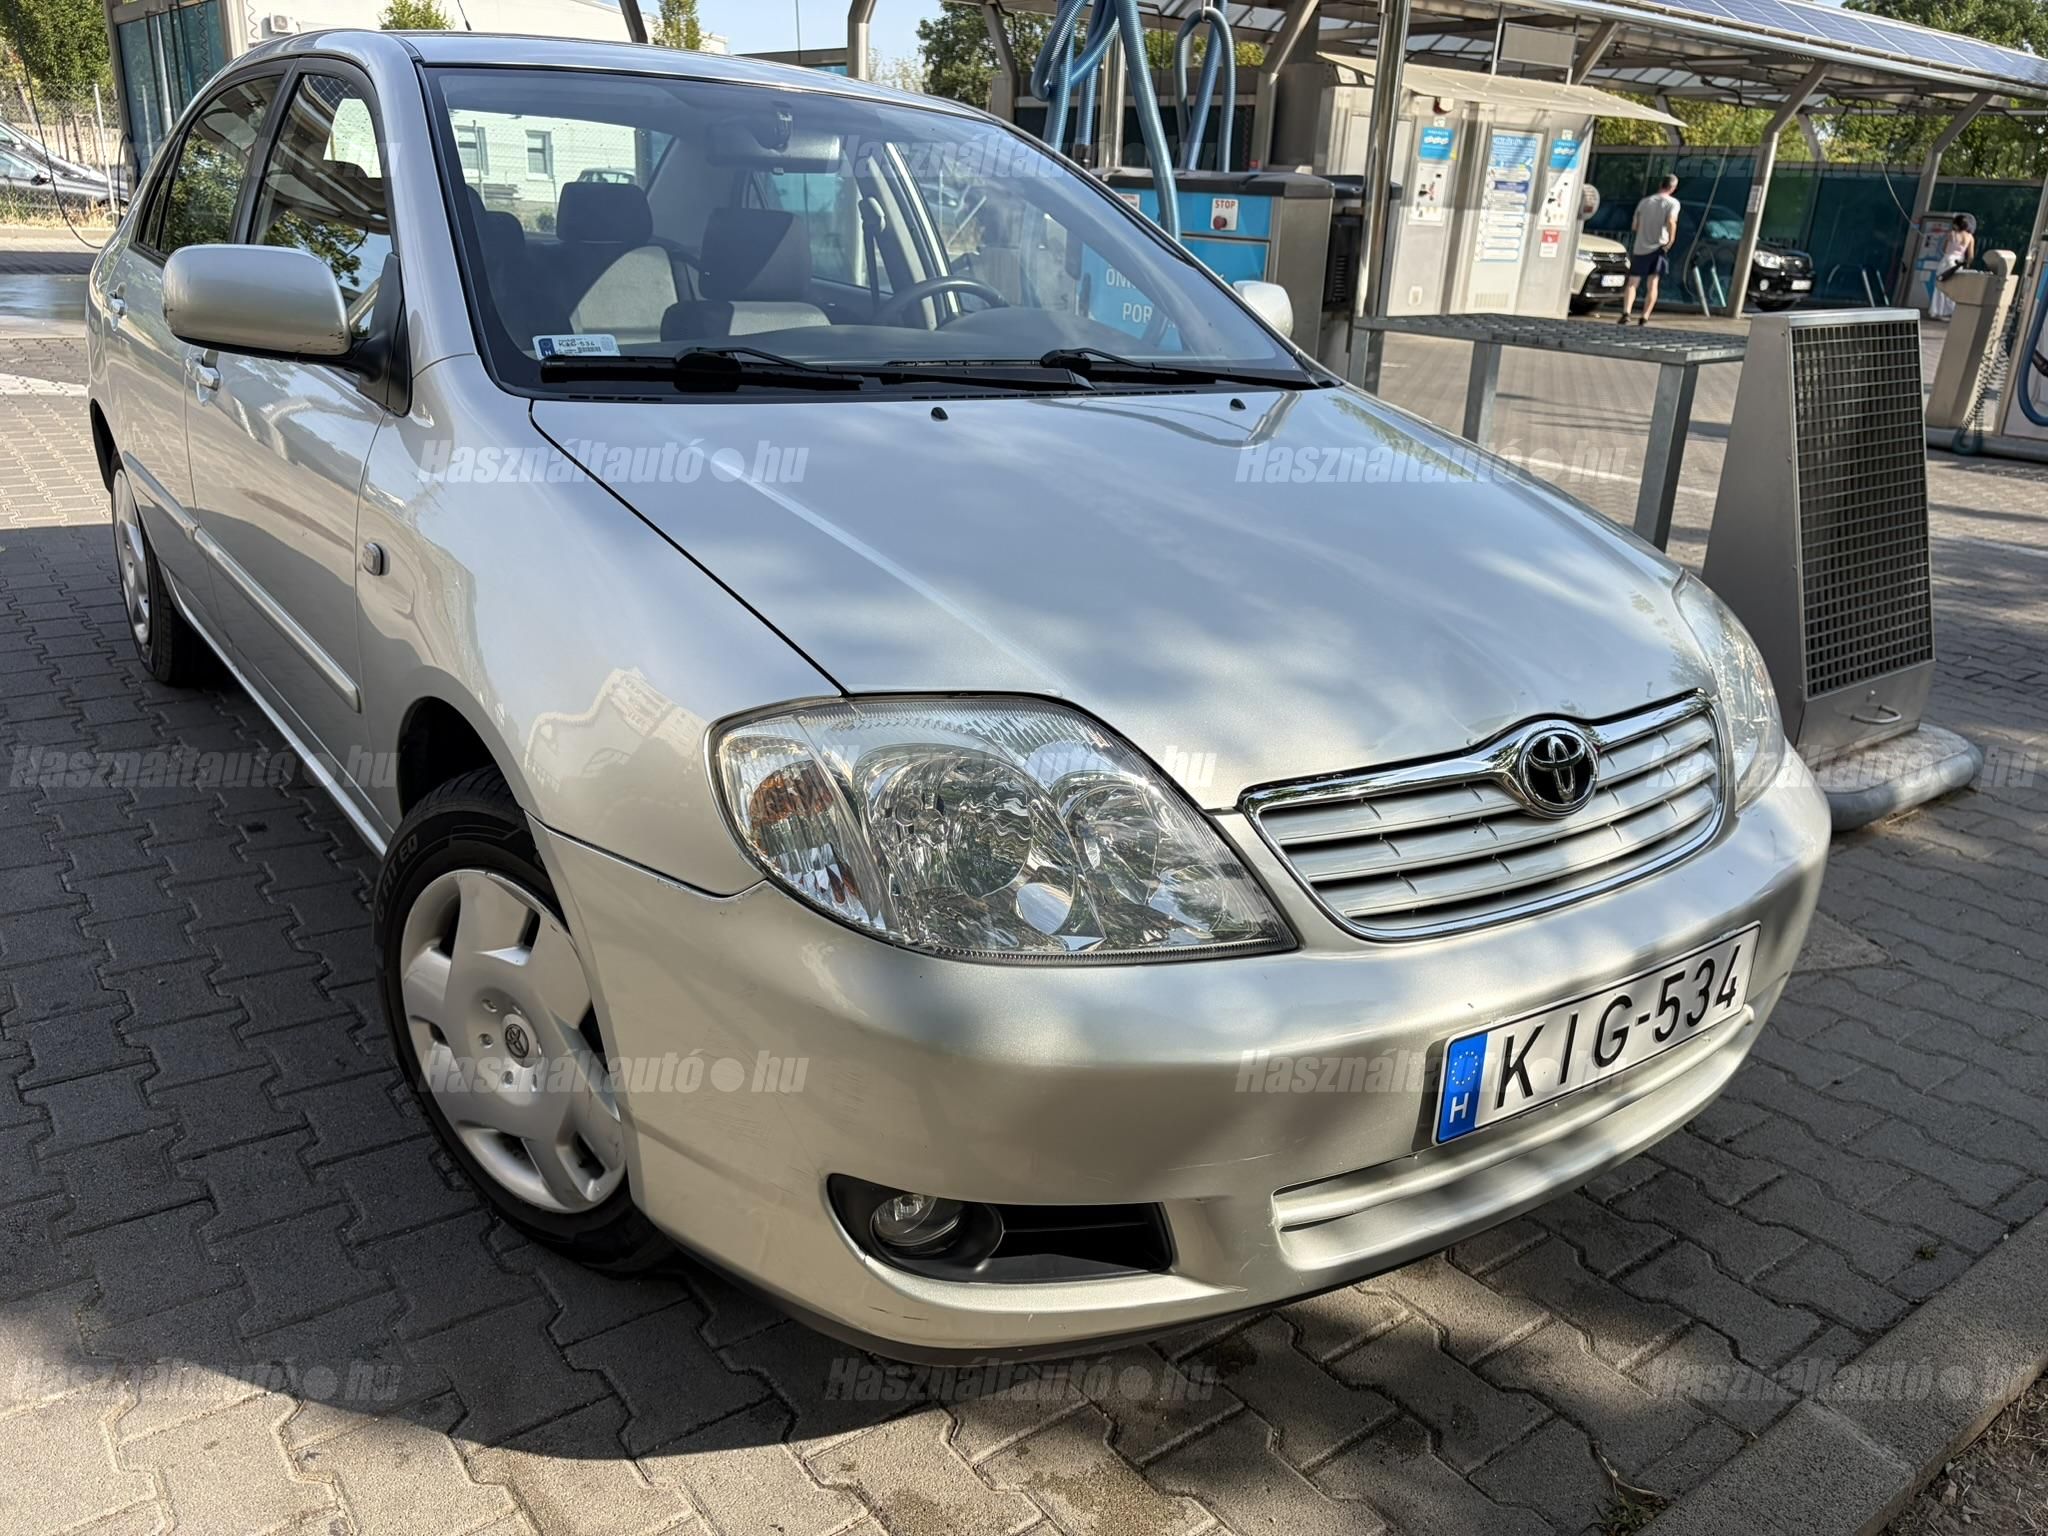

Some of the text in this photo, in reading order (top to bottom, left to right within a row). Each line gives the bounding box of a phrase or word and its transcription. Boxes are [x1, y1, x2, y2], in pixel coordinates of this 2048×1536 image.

[1214, 199, 1236, 210] STOP
[1494, 943, 1742, 1111] KIG-534
[1449, 1091, 1470, 1124] H
